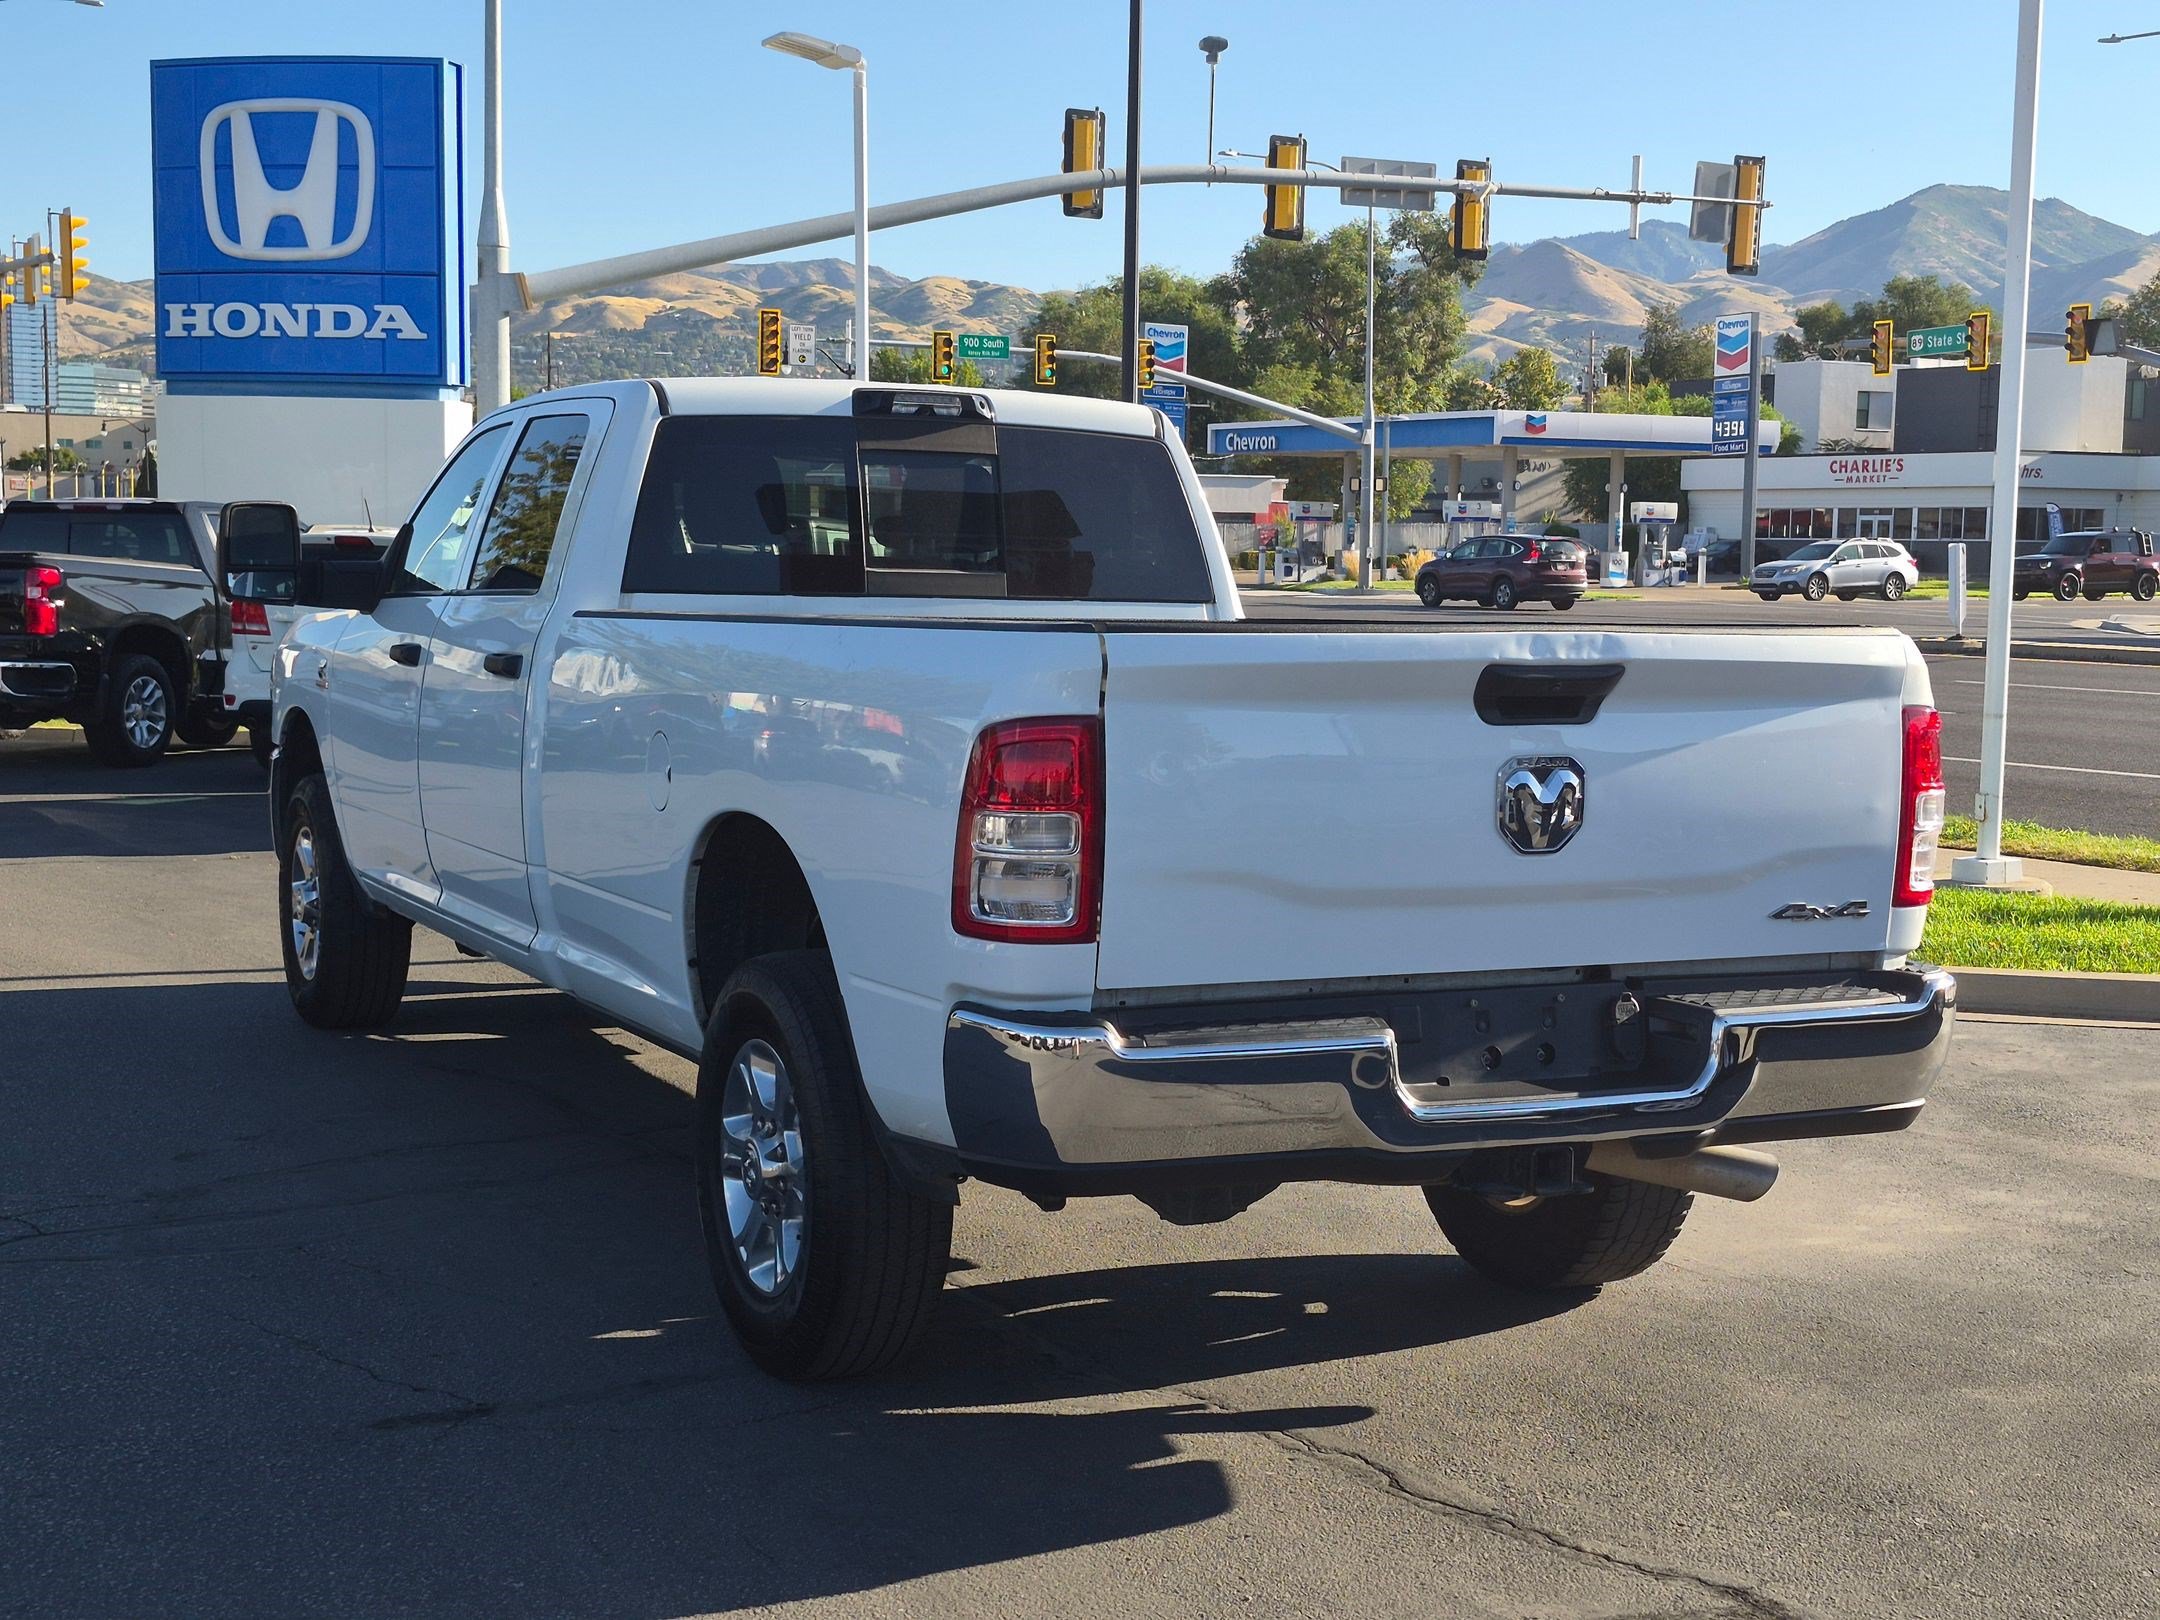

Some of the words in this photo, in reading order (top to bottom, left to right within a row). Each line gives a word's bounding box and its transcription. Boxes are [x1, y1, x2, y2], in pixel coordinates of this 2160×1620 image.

[164, 302, 428, 340] HONDA
[1717, 319, 1749, 330] Chevron
[794, 333, 811, 341] YIELD
[1147, 327, 1185, 339] Chevron
[963, 337, 980, 348] 900
[982, 338, 1005, 349] South
[1912, 338, 1922, 348] 89
[1927, 335, 1953, 348] State
[1956, 331, 1967, 345] St
[1225, 432, 1276, 451] Chevron
[1714, 443, 1729, 452] Food
[1730, 442, 1745, 451] Mart
[1829, 457, 1904, 474] CHARLIE'S
[2020, 464, 2044, 479] hrs.
[1845, 475, 1887, 484] MARKET
